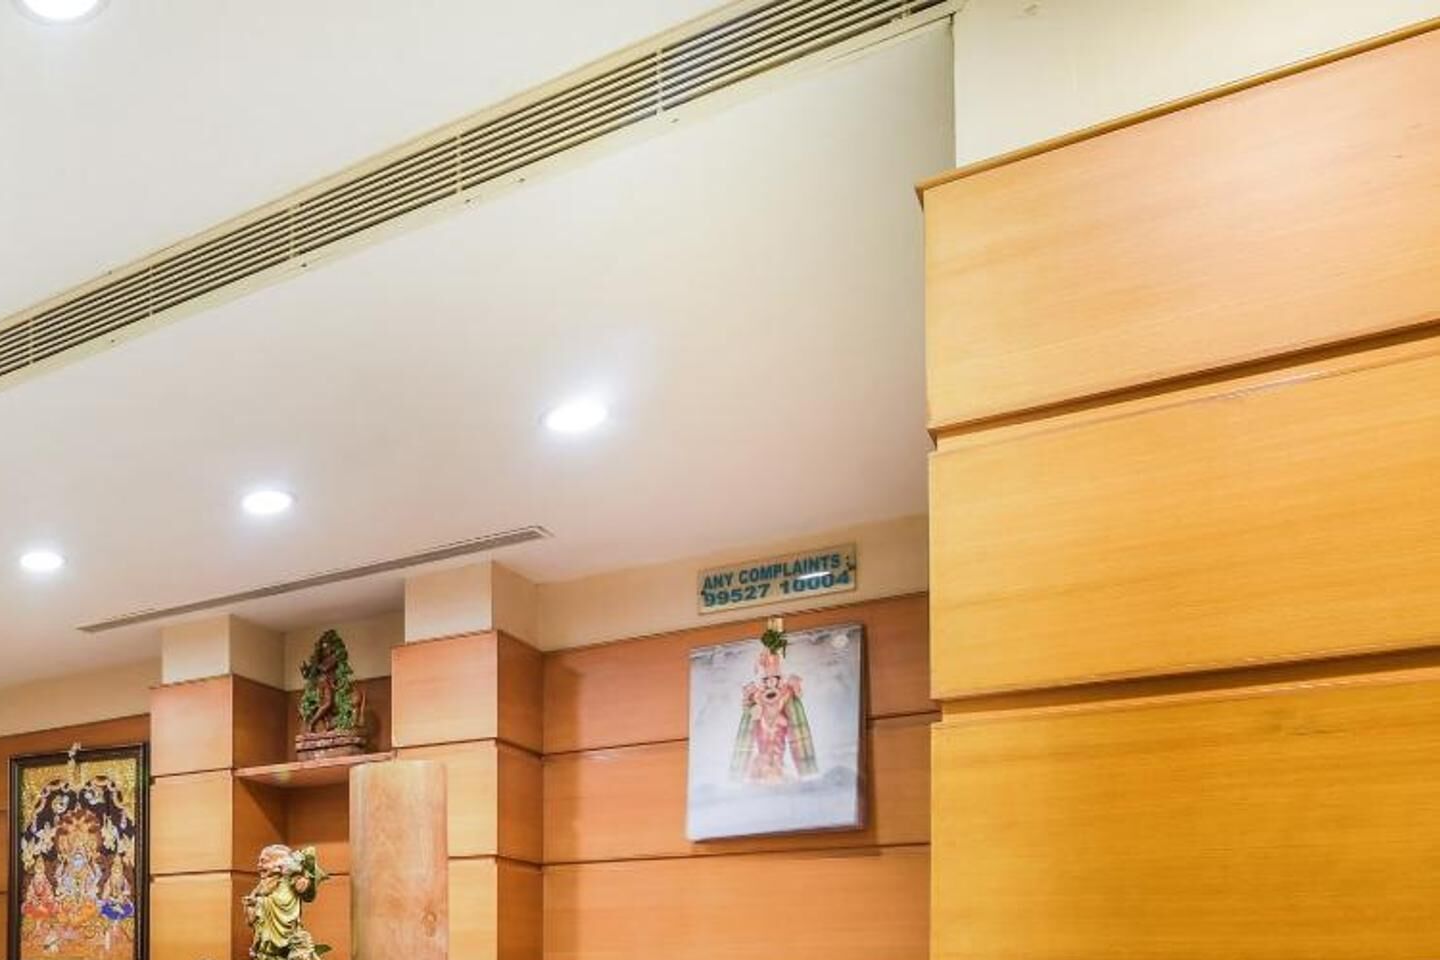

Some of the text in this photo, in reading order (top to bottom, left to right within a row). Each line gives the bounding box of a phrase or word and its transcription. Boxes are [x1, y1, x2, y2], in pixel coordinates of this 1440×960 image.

[703, 570, 850, 607] 99527 10004
[704, 571, 734, 590] ANY
[738, 553, 841, 585] COMPLAINTS
